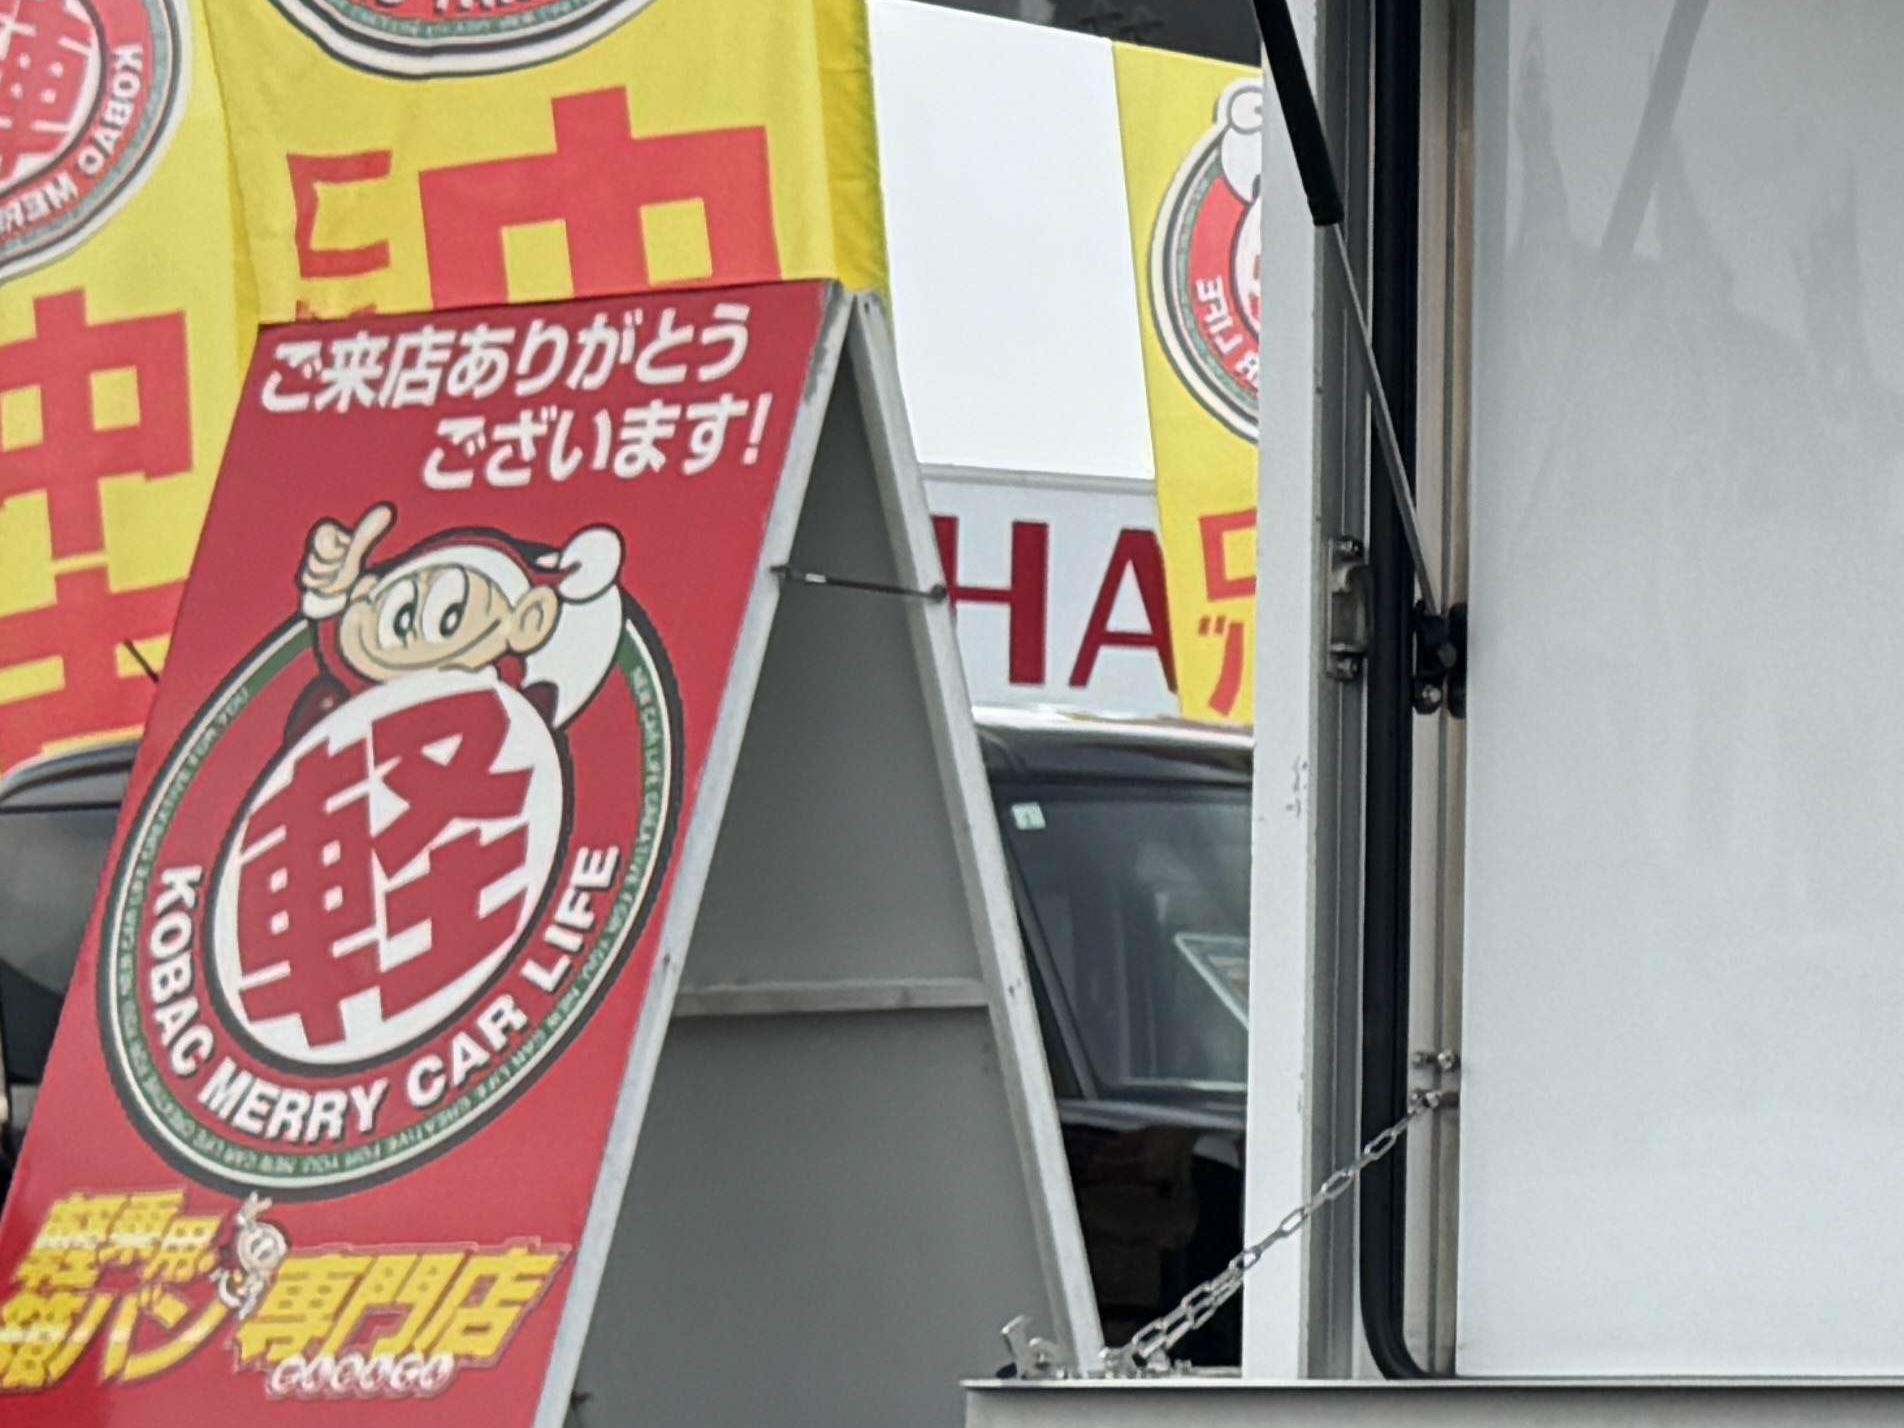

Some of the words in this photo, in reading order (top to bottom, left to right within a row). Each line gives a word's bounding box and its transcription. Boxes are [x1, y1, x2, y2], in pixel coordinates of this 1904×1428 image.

[260, 303, 750, 413] ご来店ありがとう
[422, 393, 773, 490] ございます!
[236, 687, 535, 1050] 軽
[150, 865, 213, 1075] KOBAC
[199, 1057, 389, 1143] MERRY
[406, 994, 528, 1107] CAR
[522, 845, 619, 993] LIFE
[238, 1248, 561, 1359] 専門店
